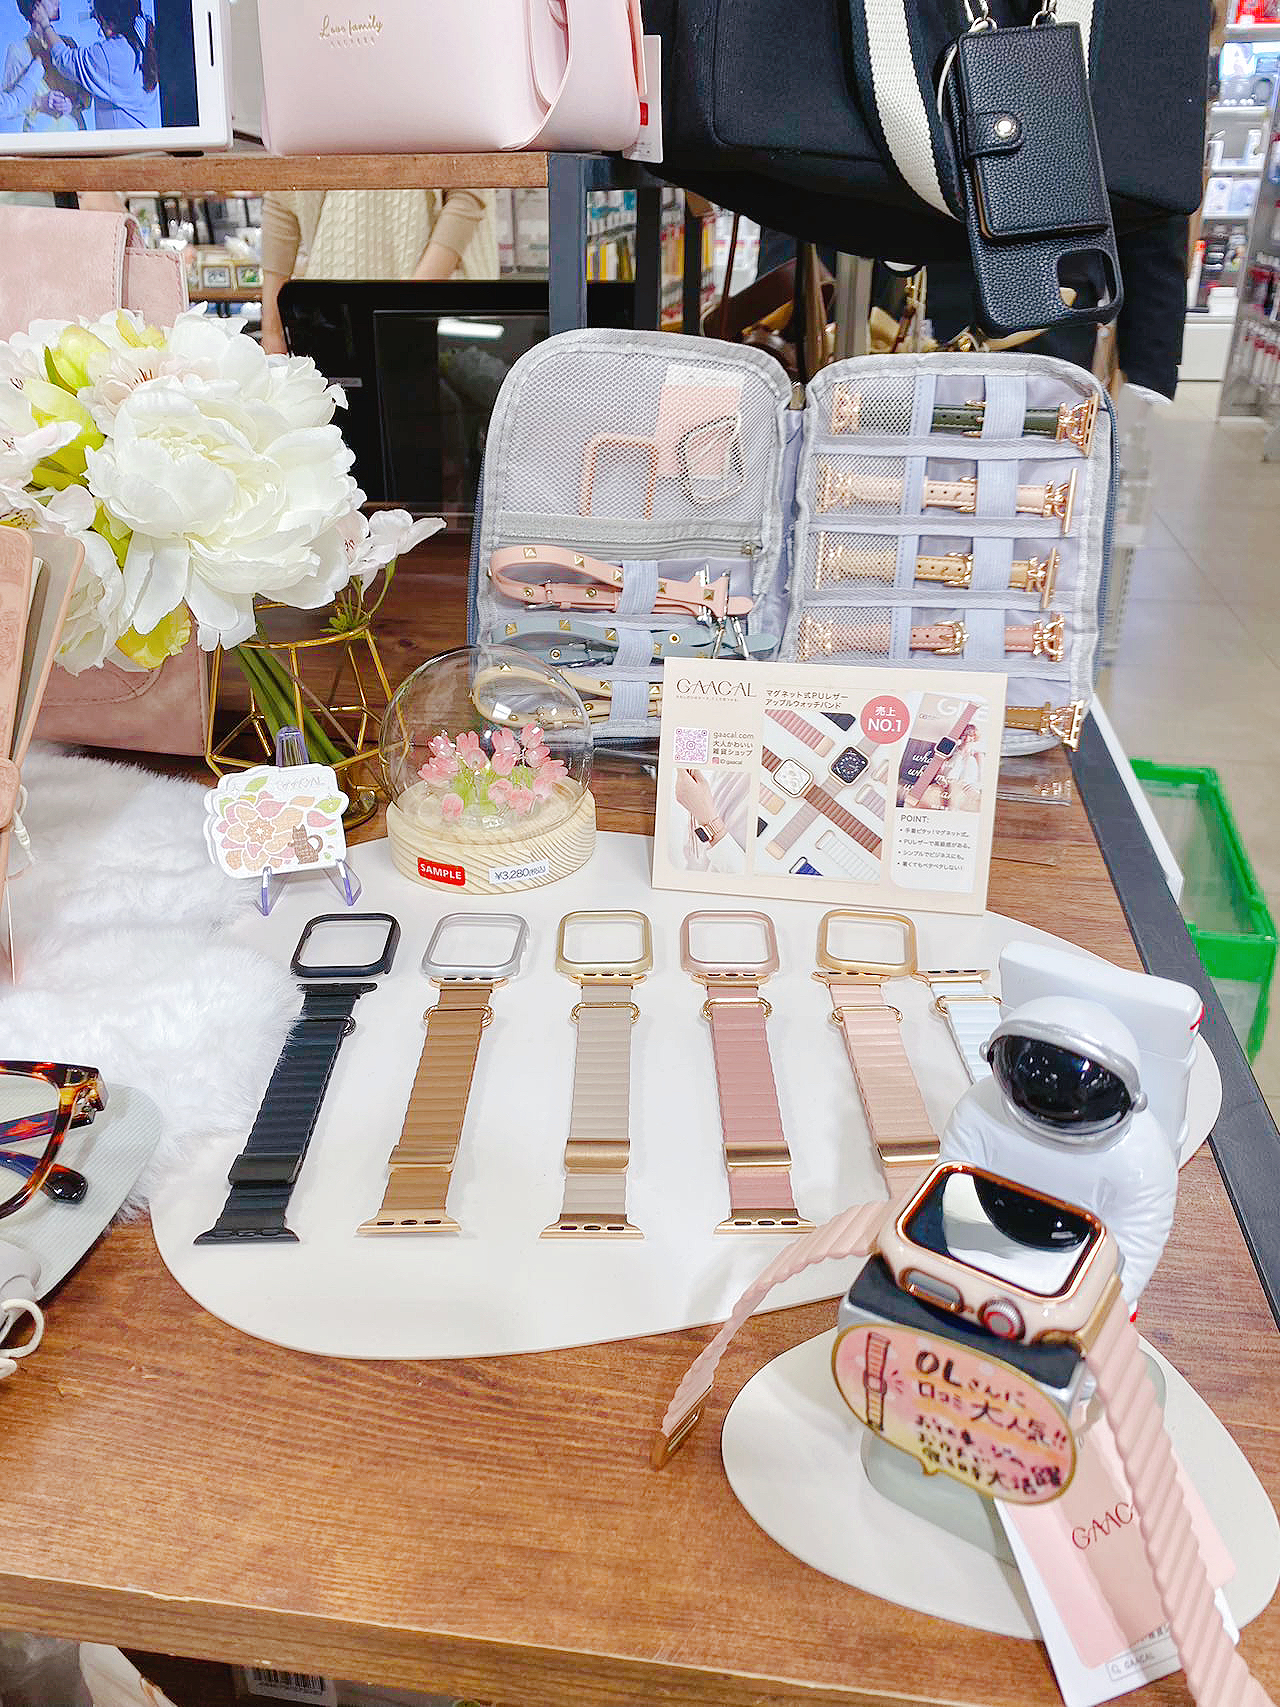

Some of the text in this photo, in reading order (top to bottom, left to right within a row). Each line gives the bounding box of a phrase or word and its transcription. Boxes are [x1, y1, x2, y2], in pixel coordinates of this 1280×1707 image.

[347, 15, 383, 36] family
[676, 678, 757, 698] GAACAL
[766, 689, 849, 700] マグネット式PUレザー
[764, 699, 842, 709] アップルウォッチバンド
[874, 706, 896, 717] 売上
[867, 718, 903, 733] NO.1
[713, 732, 754, 740] gaacal.com
[713, 740, 753, 748] 大人かわいい
[712, 748, 753, 757] 雑貨ショップ
[900, 814, 930, 823] POINT:
[420, 863, 462, 880] SAMPLE
[1072, 1502, 1133, 1550] GAAC
